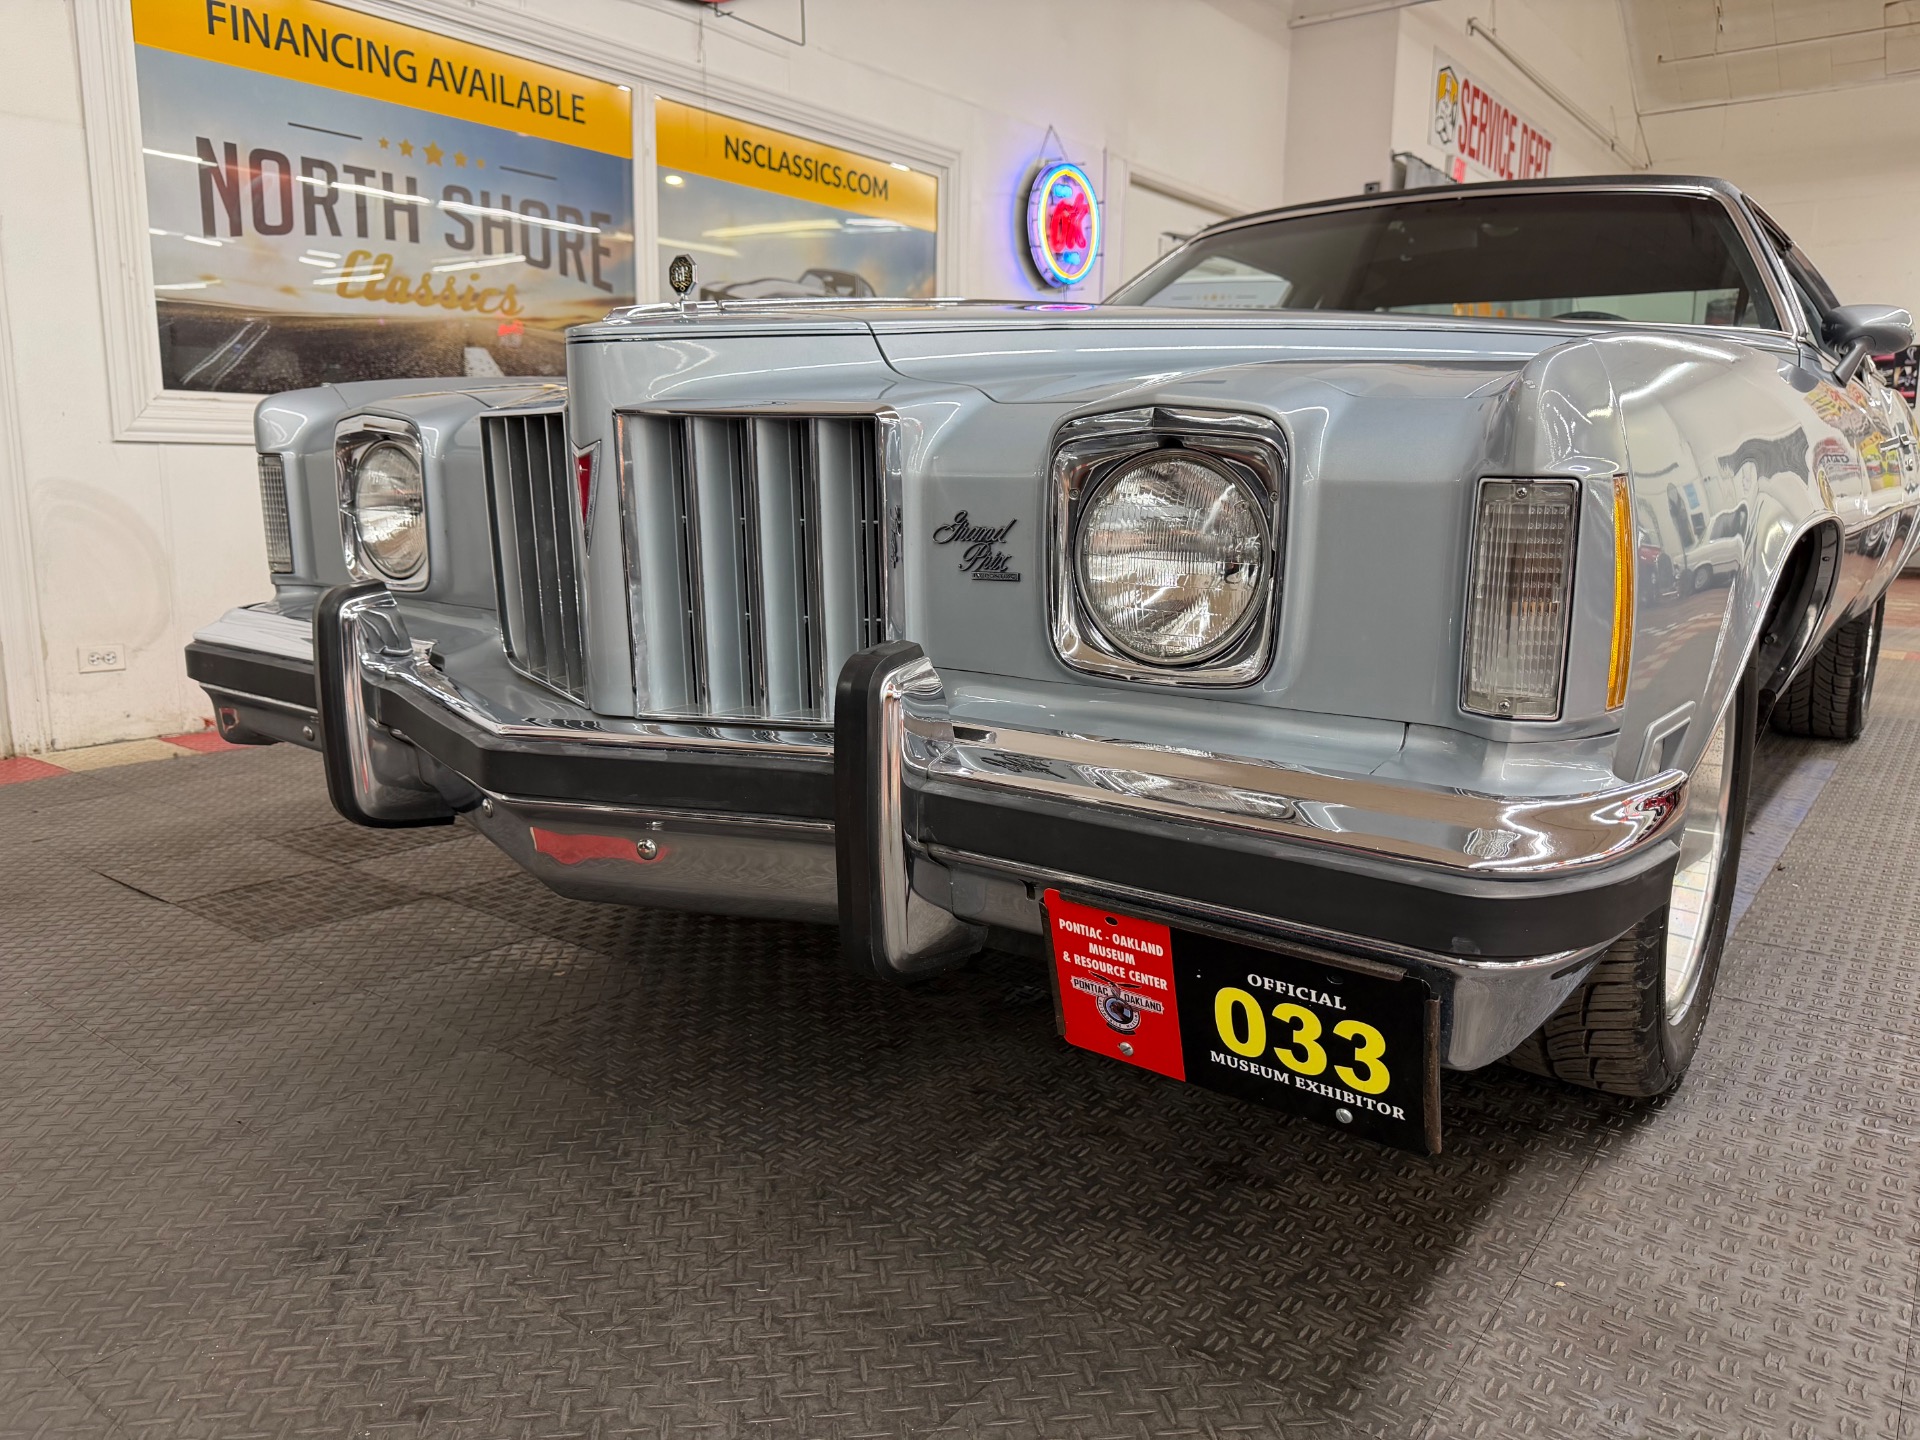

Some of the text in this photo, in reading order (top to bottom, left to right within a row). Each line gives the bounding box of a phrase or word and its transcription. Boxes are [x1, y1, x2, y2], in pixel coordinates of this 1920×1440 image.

[206, 0, 586, 124] FINANCING AVAILABLE
[1458, 78, 1552, 180] SERVICE DEPT
[724, 134, 888, 201] NSCLASSICS.COM
[196, 136, 614, 293] NORTH SHORE
[336, 249, 524, 316] Classics
[932, 510, 1018, 544] Grand
[958, 541, 1012, 571] Prix
[1059, 918, 1103, 940] PONTIAC
[1112, 933, 1164, 957] OAKLAND
[1089, 942, 1135, 966] MUSEUM
[1063, 951, 1168, 990] & RESOURCE CENTER
[1073, 978, 1162, 1012] PONTIAC OAKLAND
[1247, 973, 1347, 1010] OFFICIAL
[1214, 986, 1391, 1095] 033
[1210, 1050, 1406, 1121] MUSEUM EXHIBITOR
